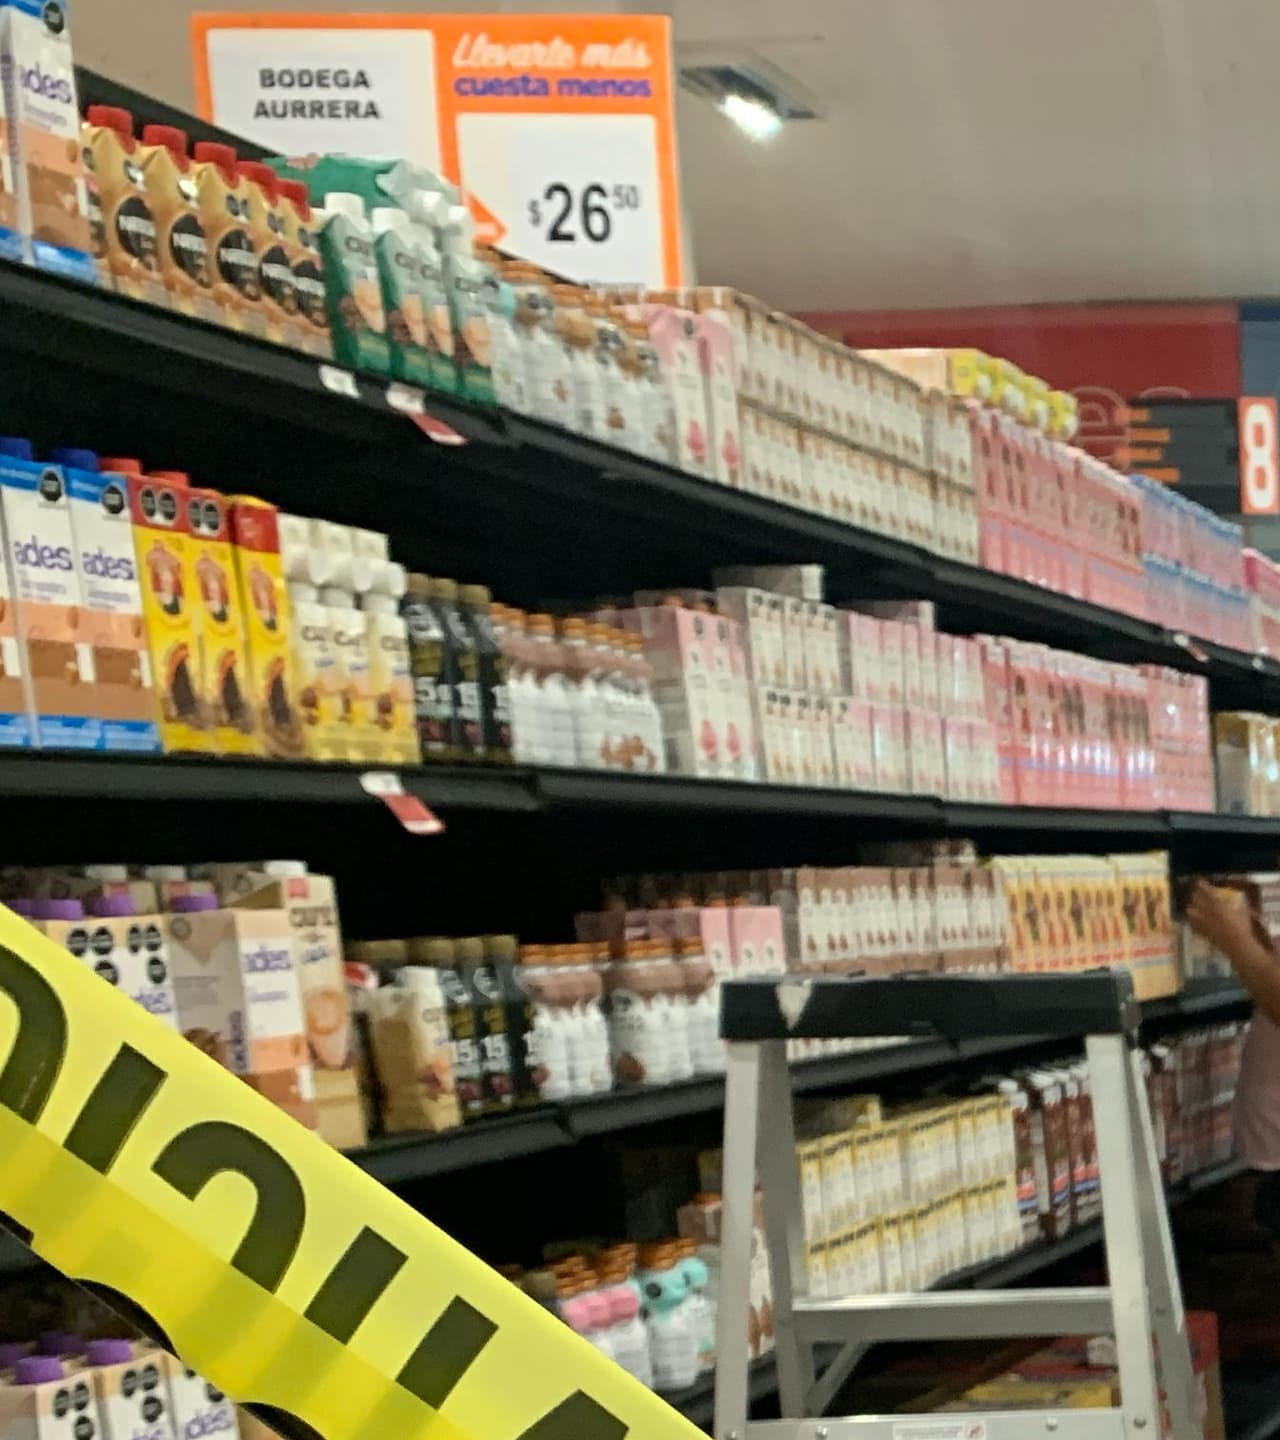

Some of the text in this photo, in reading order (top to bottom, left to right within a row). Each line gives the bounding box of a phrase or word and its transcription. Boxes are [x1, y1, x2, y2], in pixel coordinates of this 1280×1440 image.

[452, 33, 651, 70] Llevarte más
[258, 69, 371, 90] BODEGA
[454, 75, 652, 98] cuesta menos
[253, 100, 381, 121] AURRERA
[1244, 403, 1276, 508] 8
[14, 535, 73, 572] ades
[83, 547, 135, 581] ades
